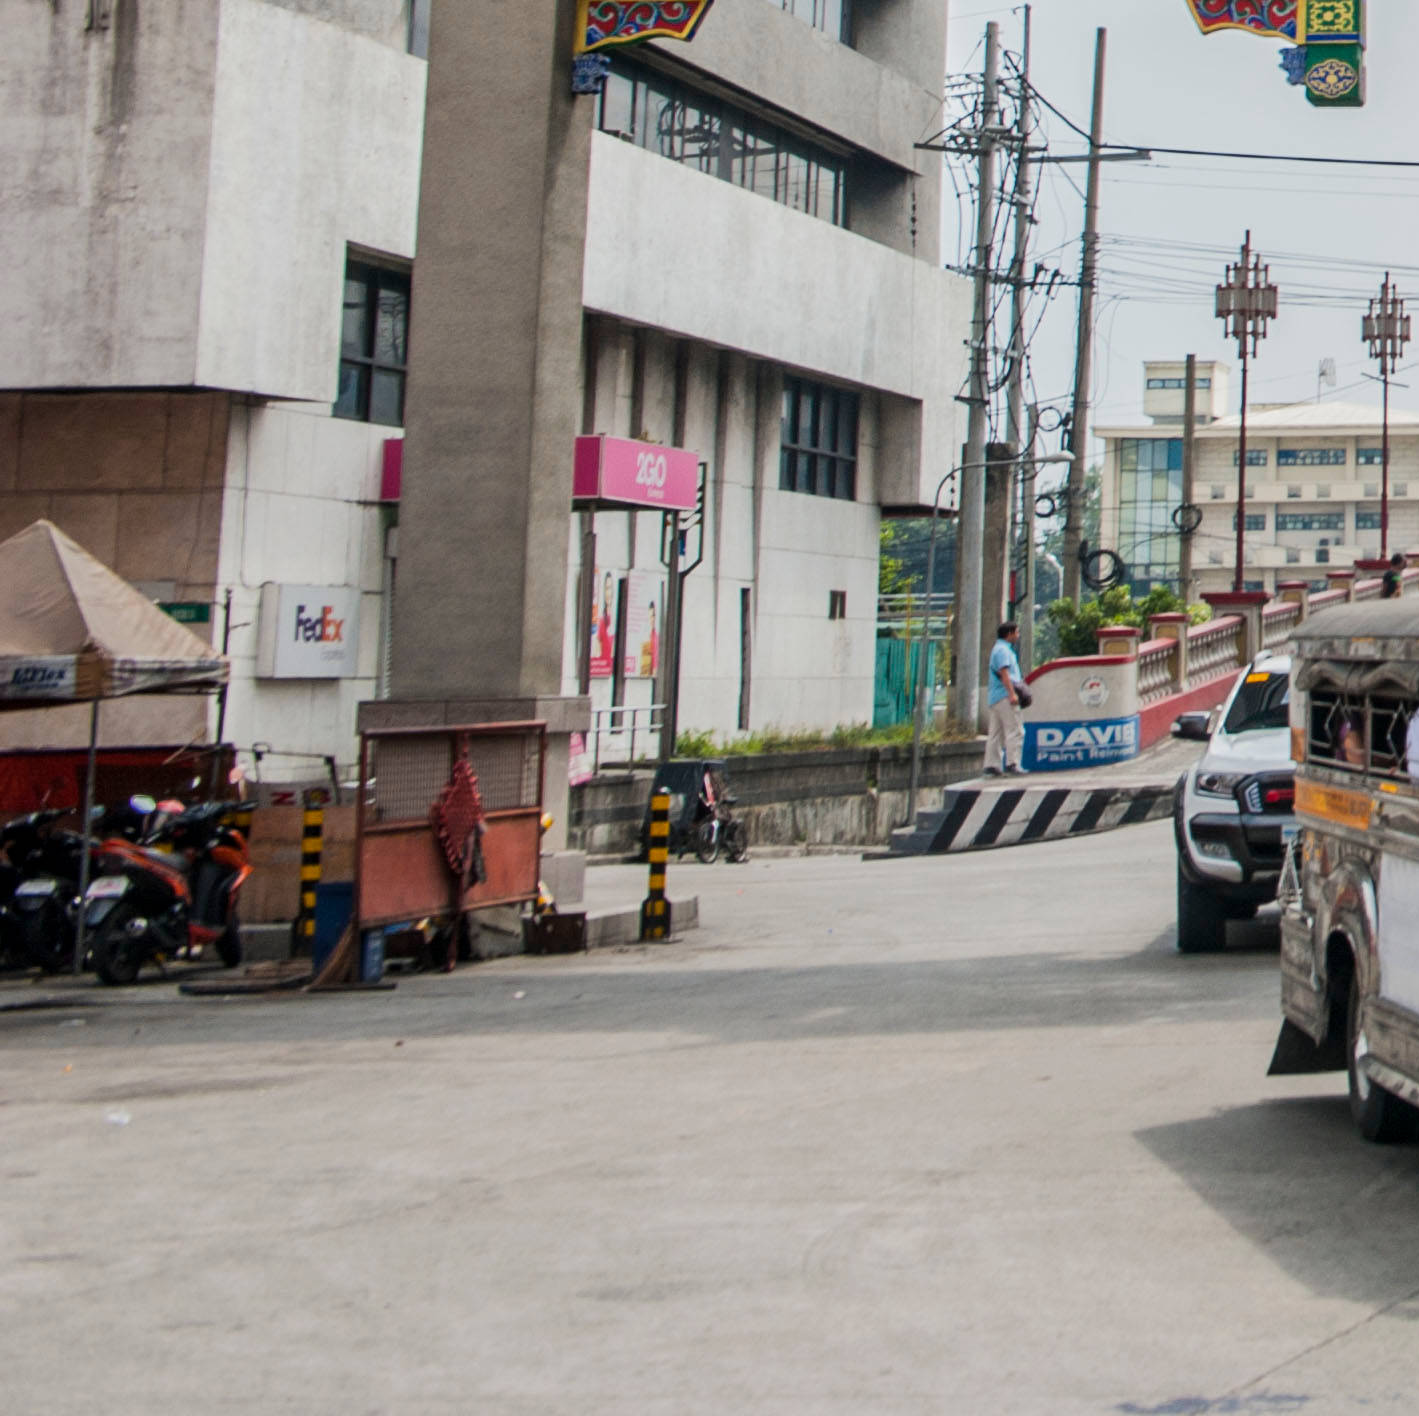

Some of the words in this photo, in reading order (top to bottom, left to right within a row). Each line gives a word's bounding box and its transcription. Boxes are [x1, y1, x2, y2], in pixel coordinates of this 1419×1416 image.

[636, 452, 667, 487] 2GO
[295, 604, 345, 642] FedEx
[1036, 722, 1136, 747] DAVIE
